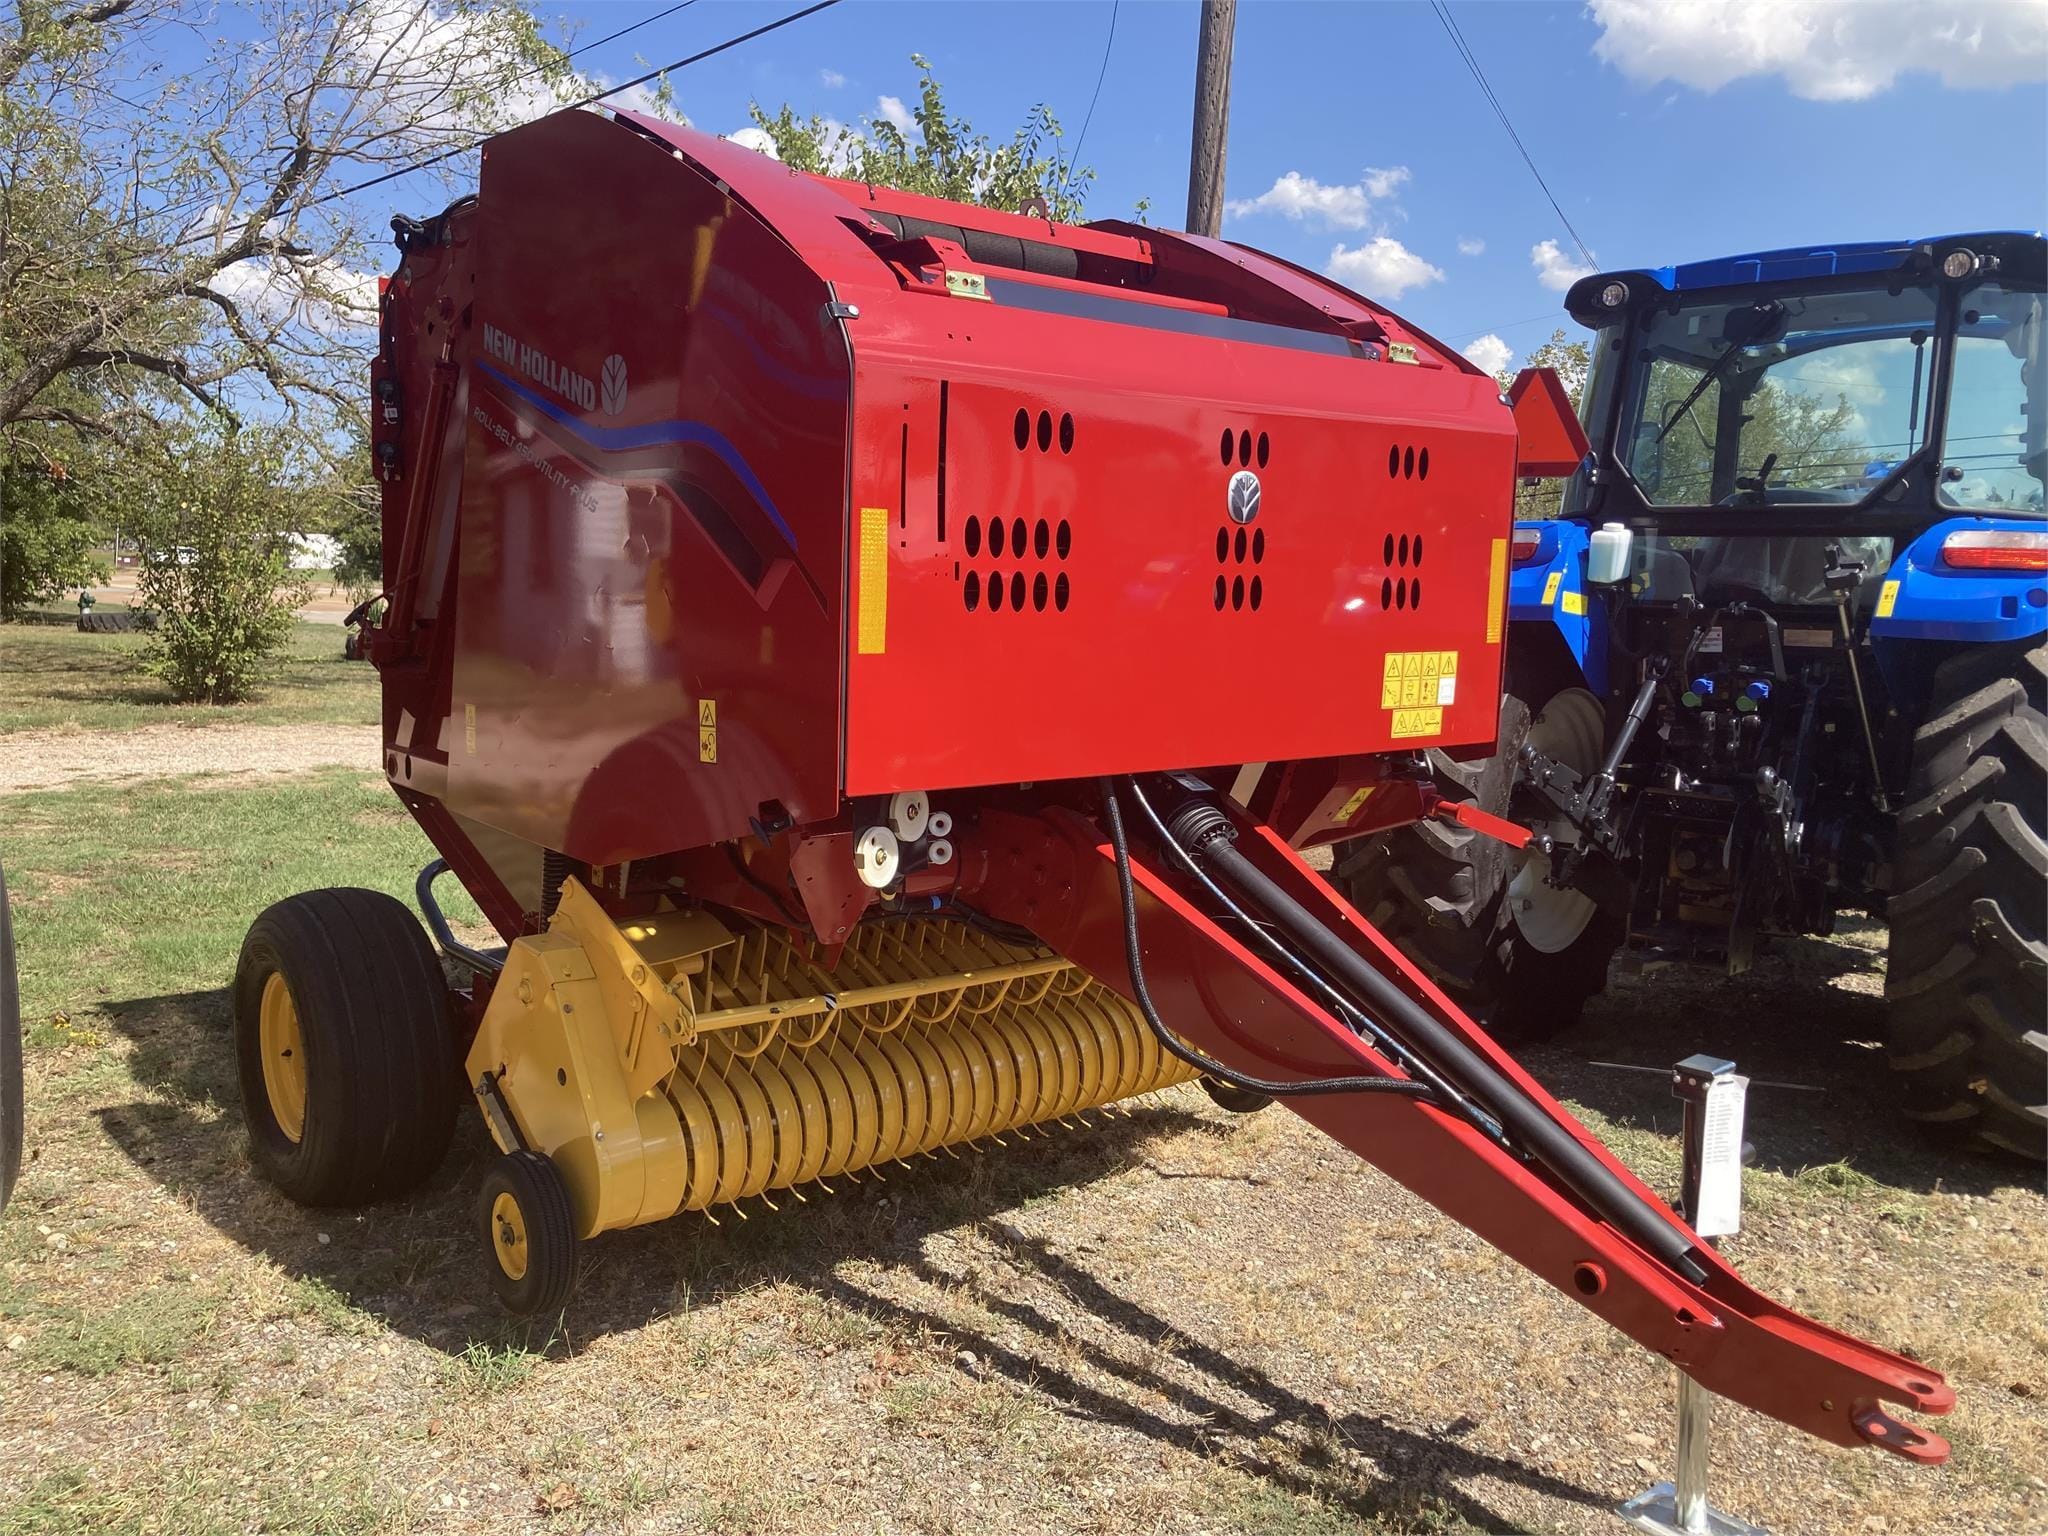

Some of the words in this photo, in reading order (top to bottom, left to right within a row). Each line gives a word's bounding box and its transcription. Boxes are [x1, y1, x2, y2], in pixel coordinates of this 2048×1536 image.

[484, 322, 516, 367] NEW
[520, 343, 596, 412] HOLLAND
[474, 406, 516, 447] ROLL-BELT
[534, 456, 570, 489] UTILITY
